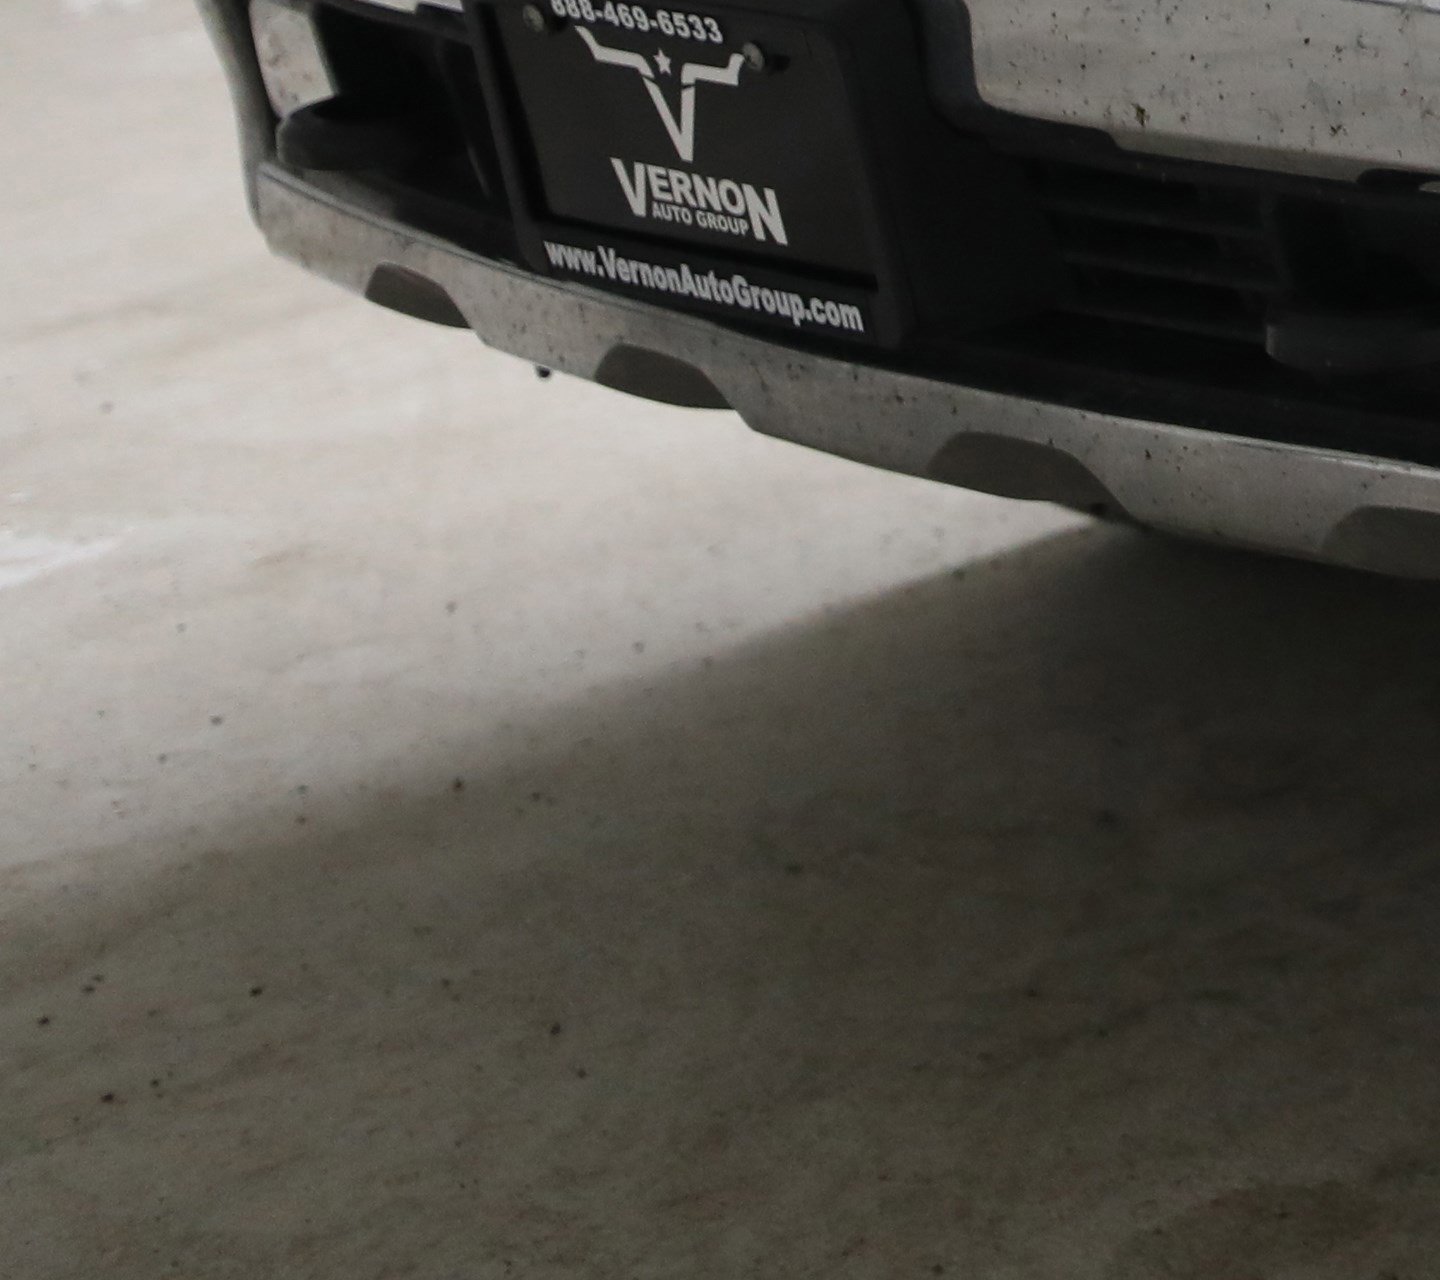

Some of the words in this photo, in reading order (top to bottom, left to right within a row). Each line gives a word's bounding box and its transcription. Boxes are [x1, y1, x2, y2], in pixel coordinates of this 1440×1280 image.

[609, 157, 788, 246] VERNON
[651, 200, 693, 226] AUTO
[695, 209, 750, 236] GROUP
[544, 241, 865, 333] www.VernonAutoGroup.com
